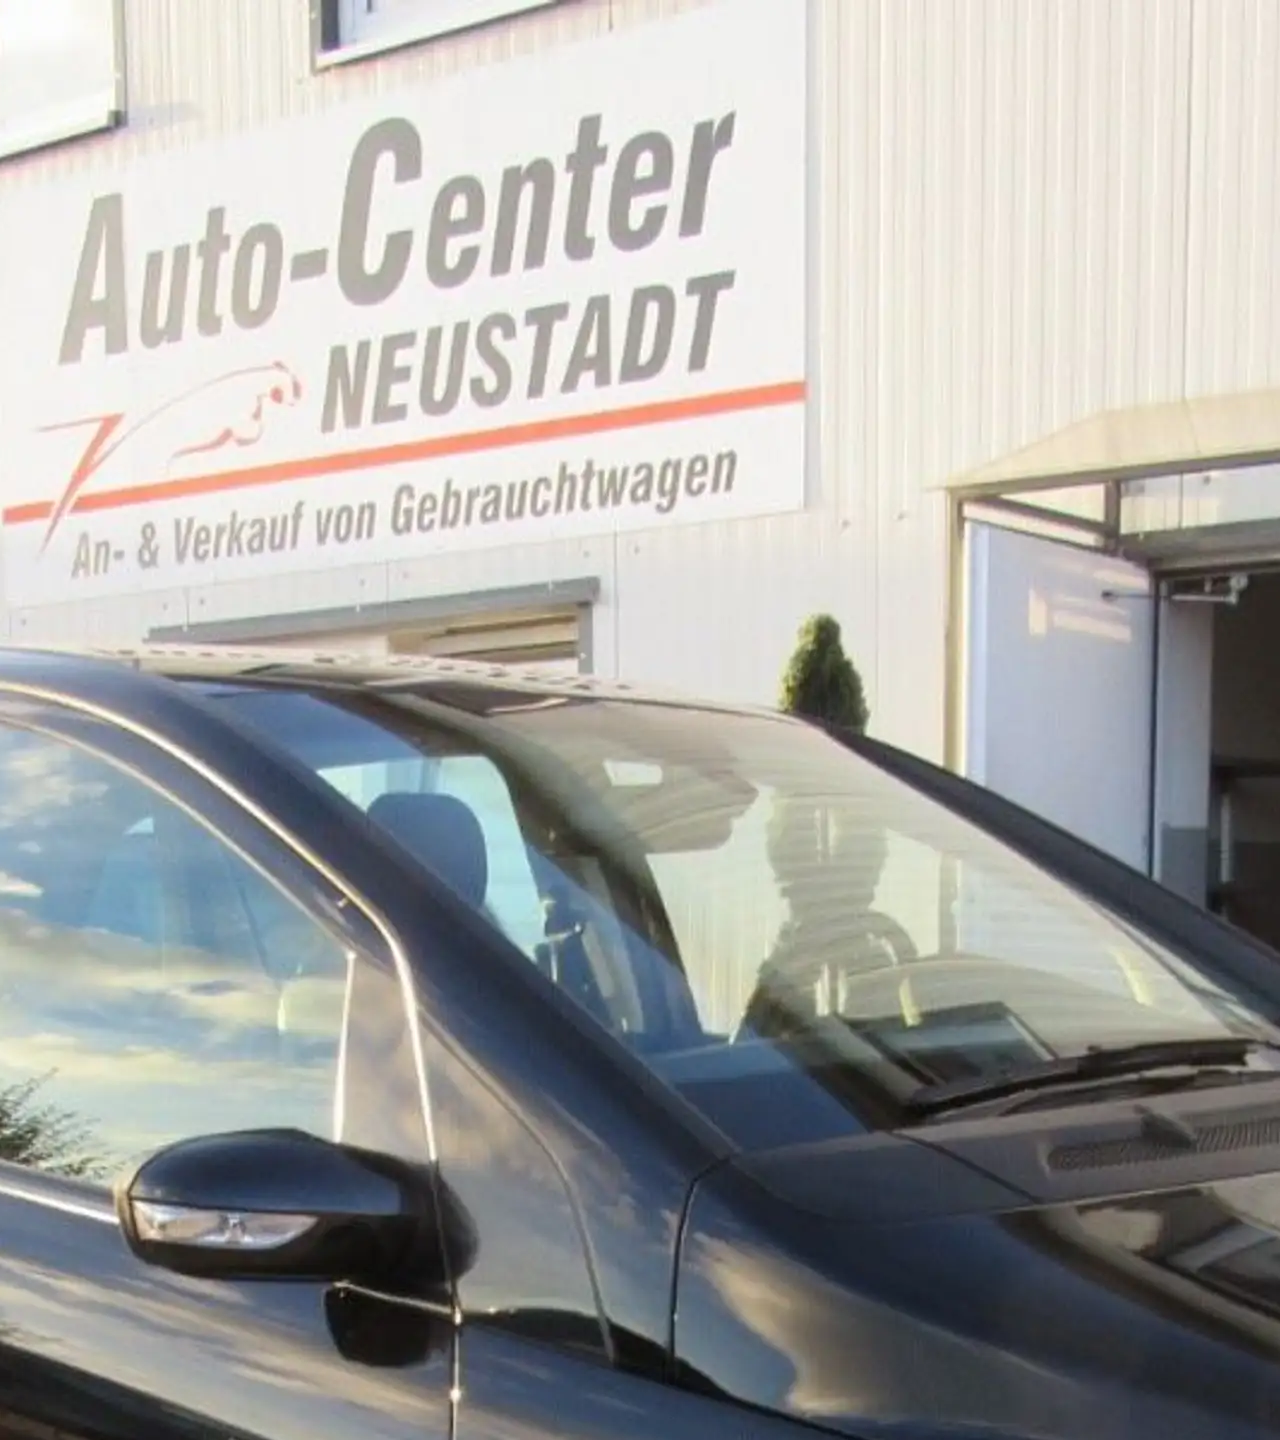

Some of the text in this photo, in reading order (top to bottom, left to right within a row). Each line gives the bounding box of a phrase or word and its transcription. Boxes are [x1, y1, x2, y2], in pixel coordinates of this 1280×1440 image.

[58, 110, 736, 365] Auto-Center
[320, 270, 737, 433] NEUSTADT
[71, 449, 739, 579] An- & Verkauf von Gebrauchtwagen
